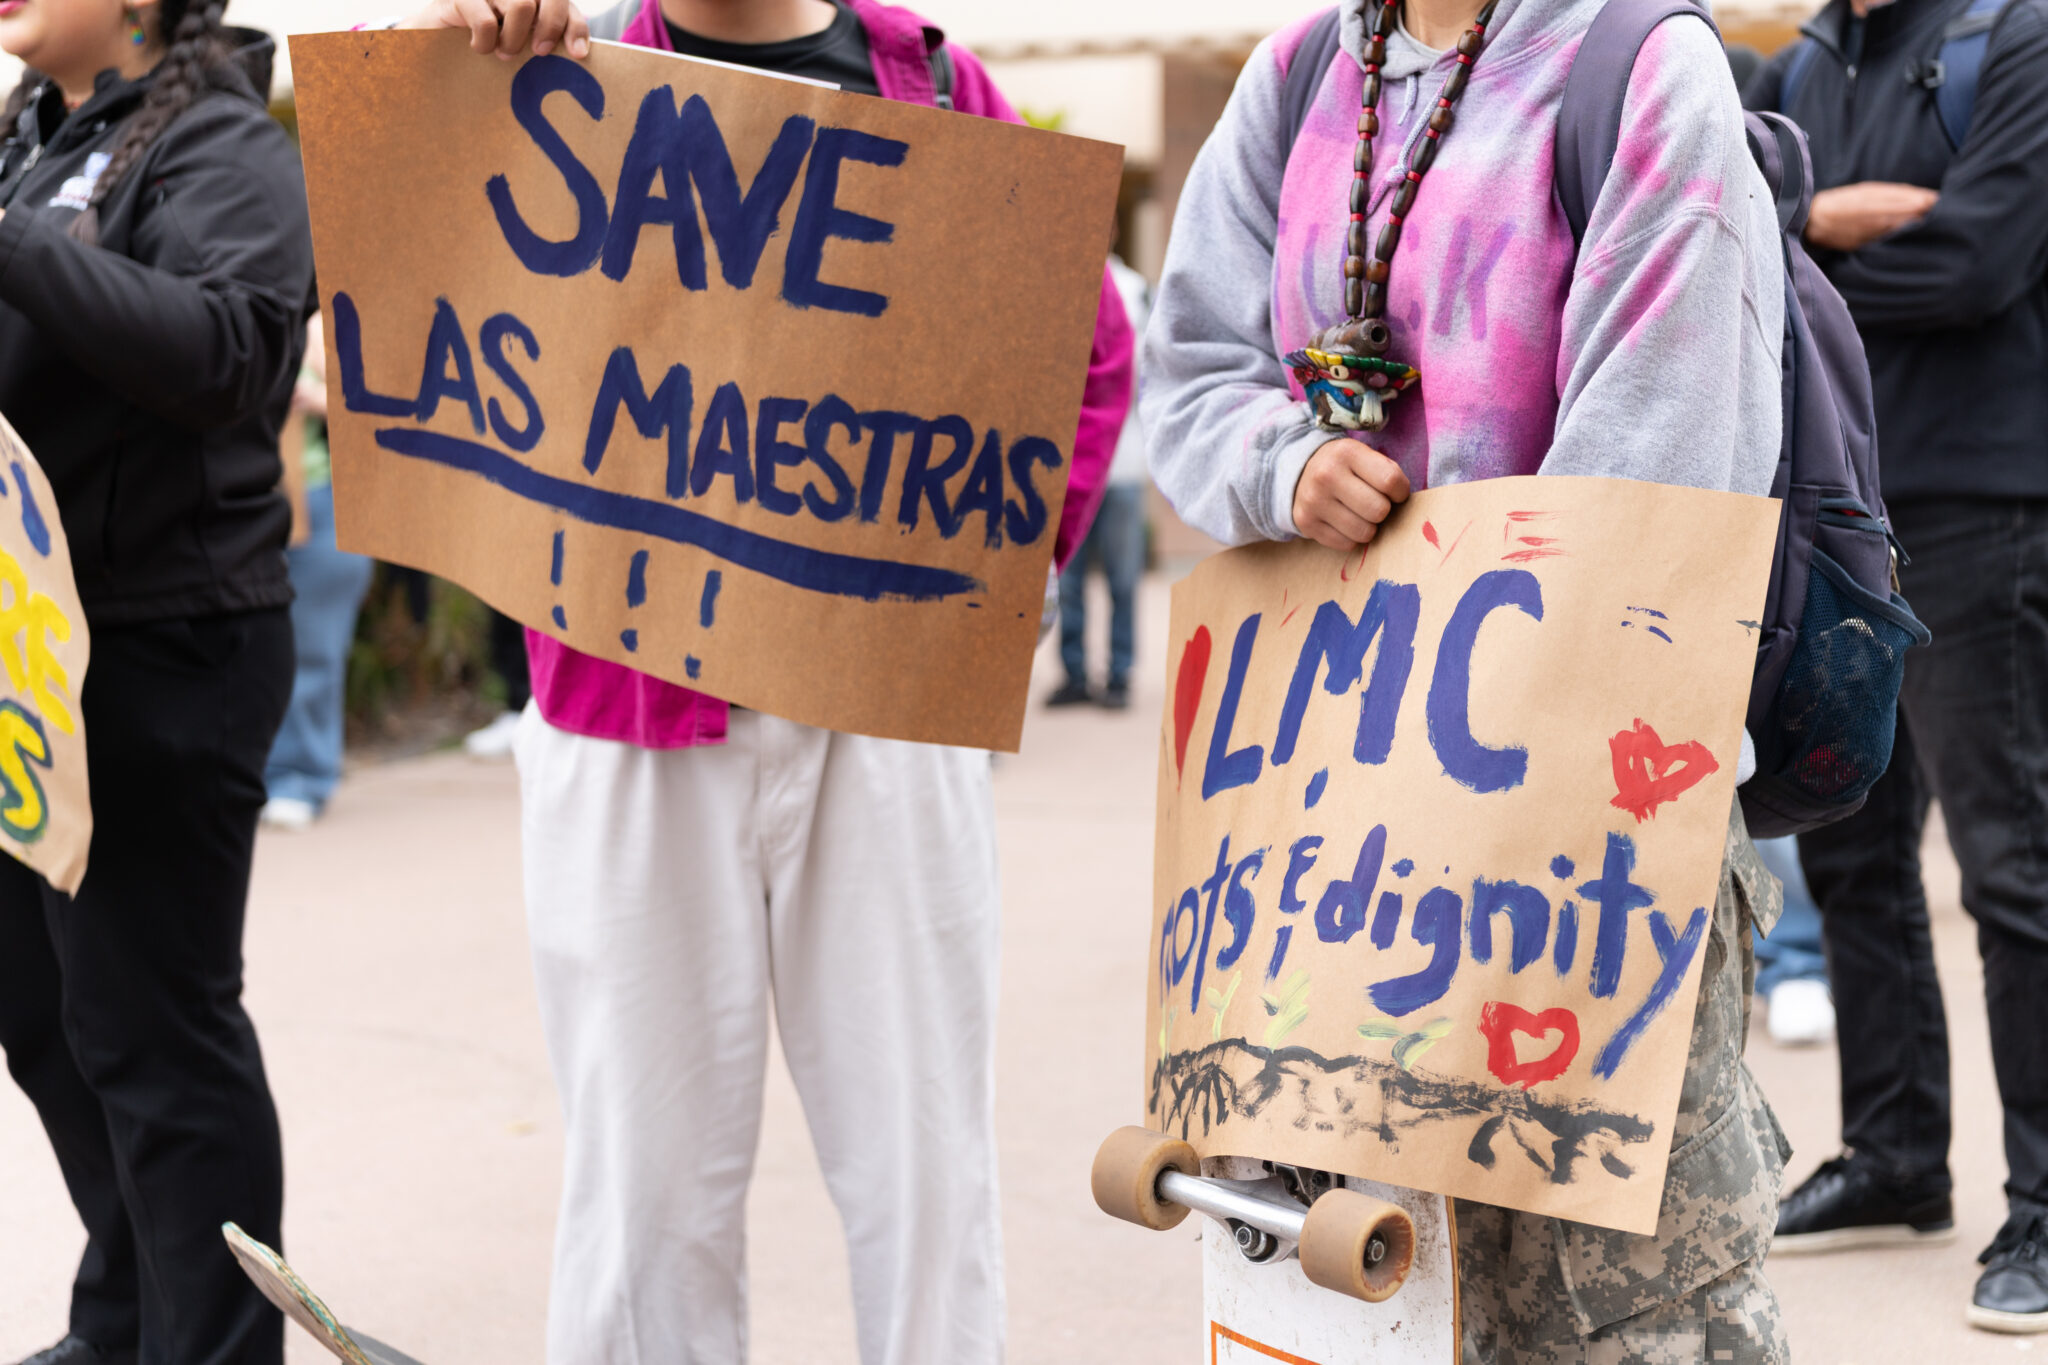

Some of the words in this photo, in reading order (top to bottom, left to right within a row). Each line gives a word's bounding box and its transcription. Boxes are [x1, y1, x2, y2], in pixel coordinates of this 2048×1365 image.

[485, 54, 910, 317] SAVE
[332, 291, 546, 453] LAS
[582, 346, 1064, 550] MAESTRAS
[1201, 568, 1545, 801] LMC
[1314, 824, 1710, 1081] dignity
